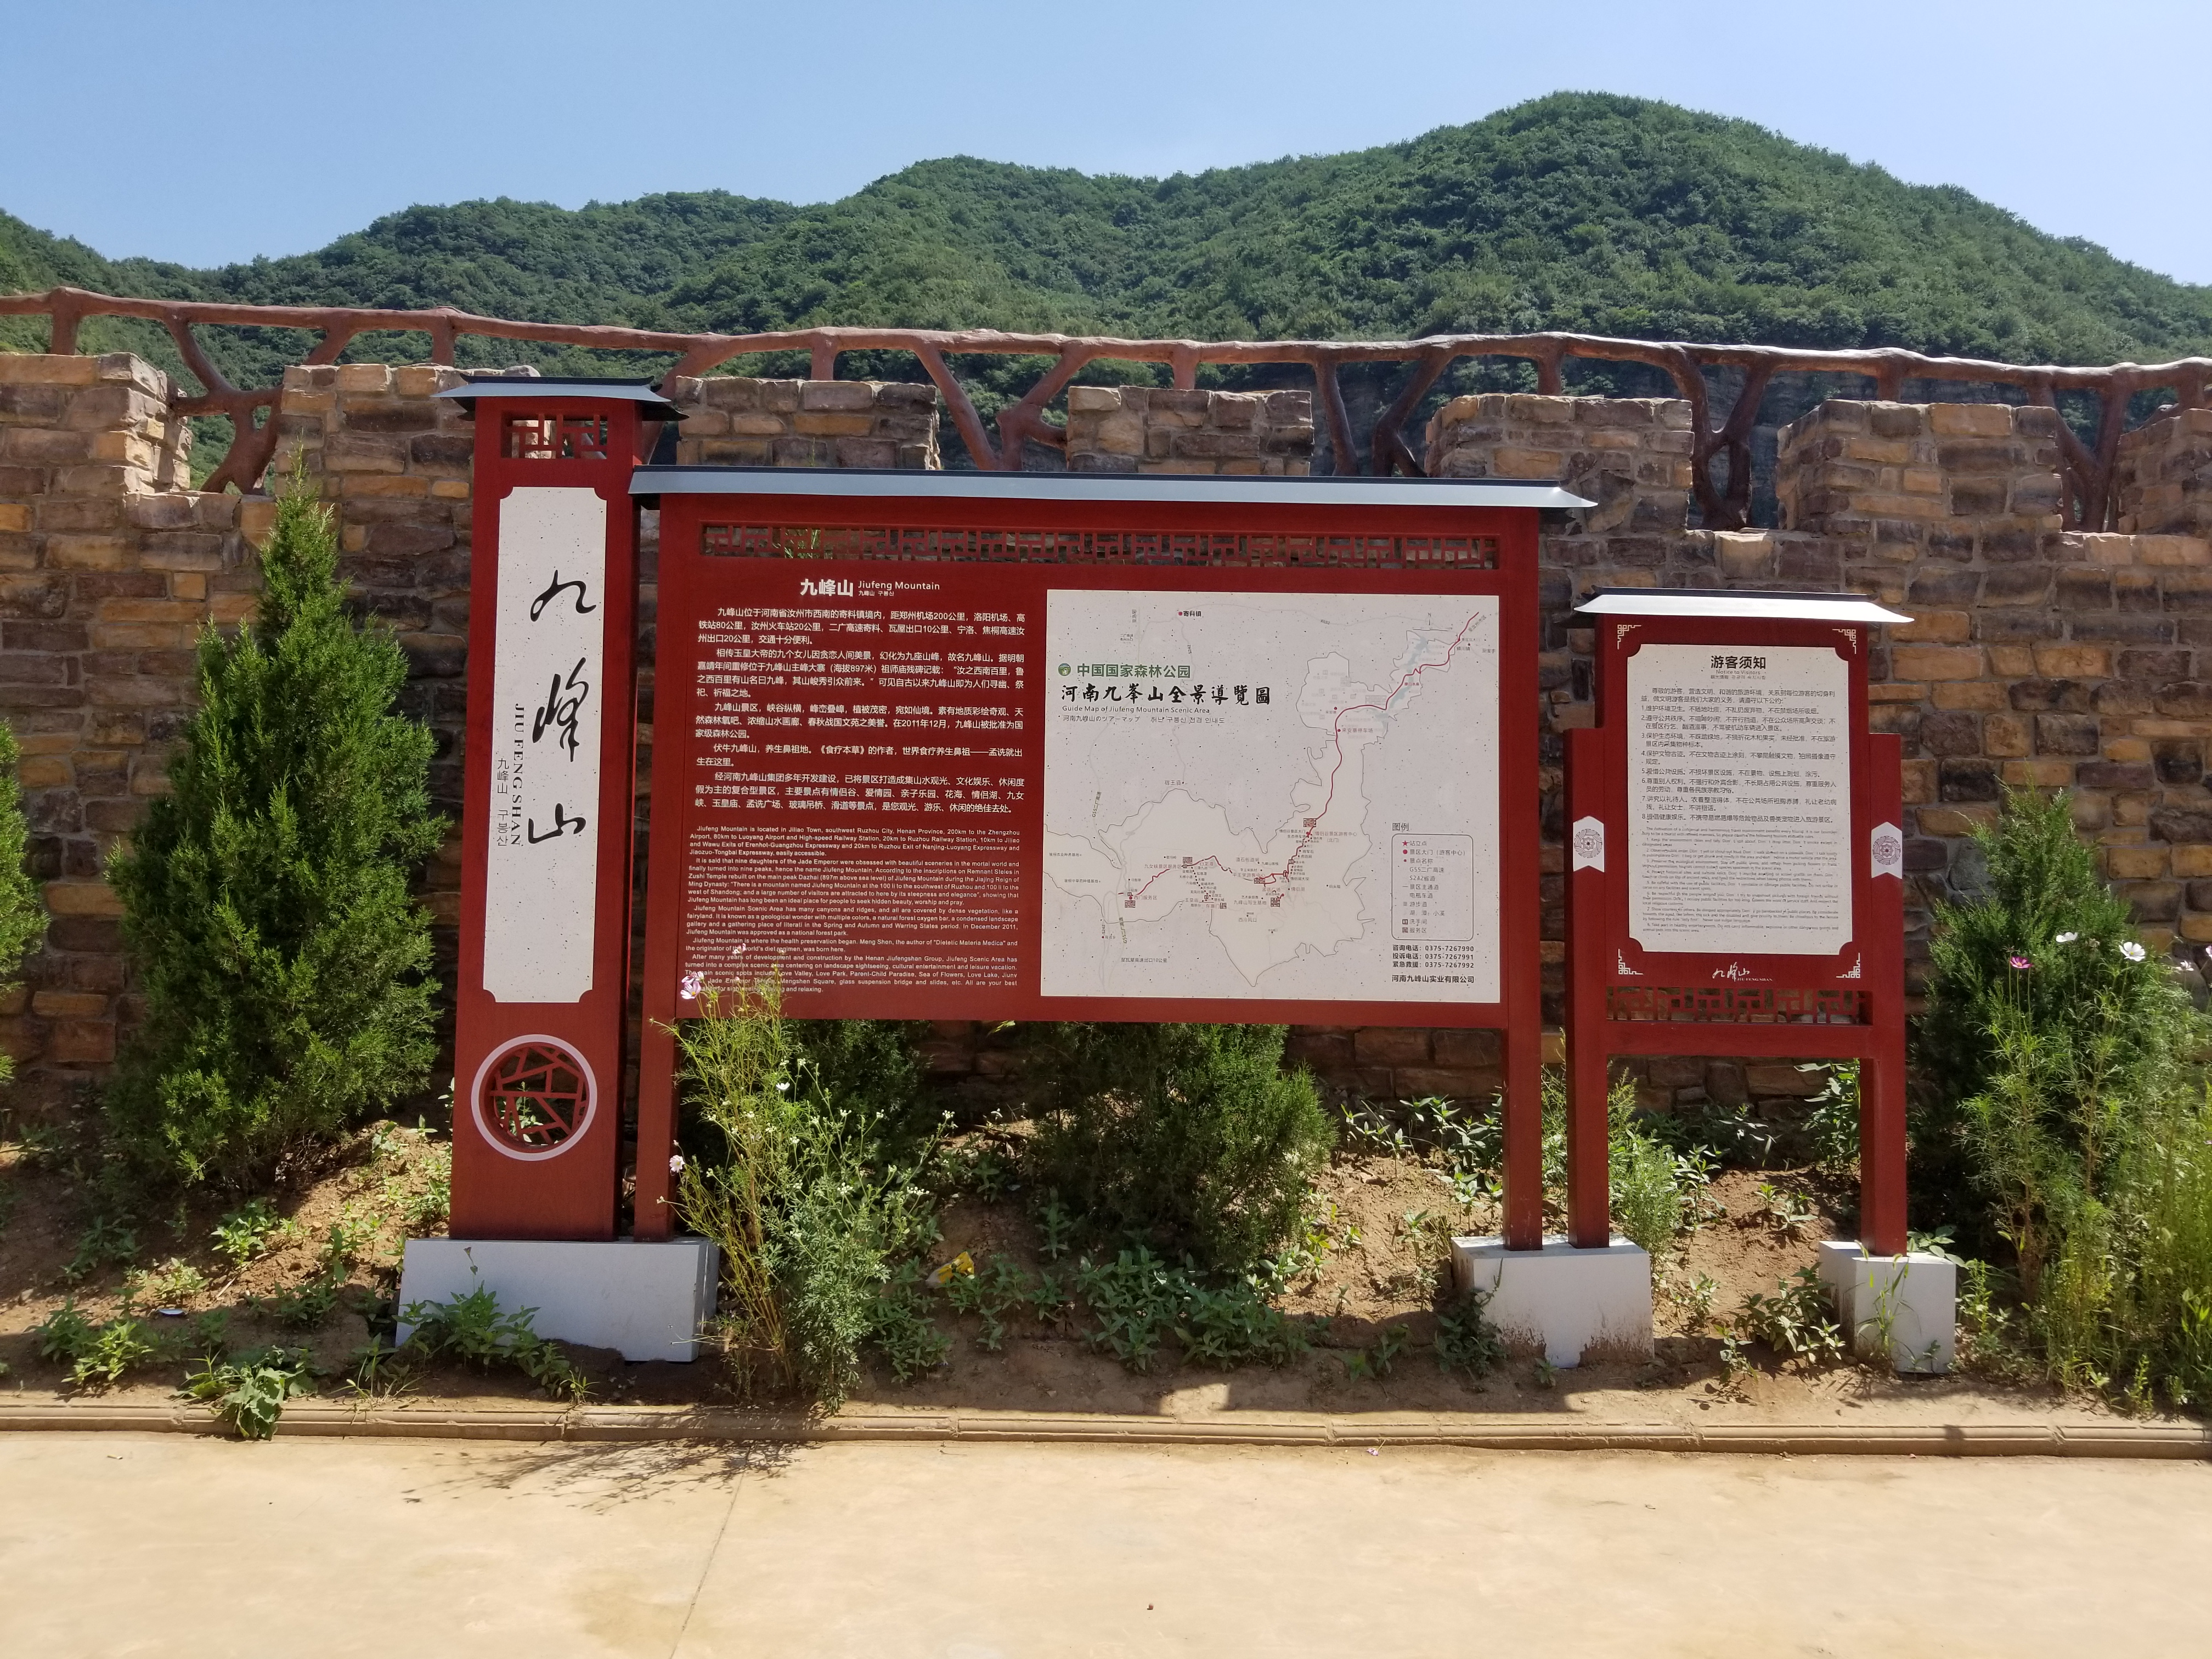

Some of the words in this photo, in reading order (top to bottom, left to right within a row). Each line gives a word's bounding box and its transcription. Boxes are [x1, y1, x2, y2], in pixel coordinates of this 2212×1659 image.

[800, 578, 853, 597] 九峰山
[858, 581, 892, 590] Jiufeng
[895, 582, 940, 590] Mountain
[1077, 663, 1190, 678] 中国国家森林公园
[1711, 656, 1767, 669] 游客须知
[528, 569, 597, 844] 九峰山
[514, 703, 524, 732] JIU
[695, 729, 749, 739] 家级森林公园。
[512, 739, 524, 789] FENG
[696, 757, 734, 766] 生在这里。
[497, 758, 509, 794] 九峰山
[496, 809, 509, 846] 구봉산
[511, 794, 522, 845] SHAN
[1392, 822, 1409, 831] 图例
[1392, 975, 1475, 984] 河南九峰山实业有限公司
[1712, 962, 1750, 982] 九峰山
